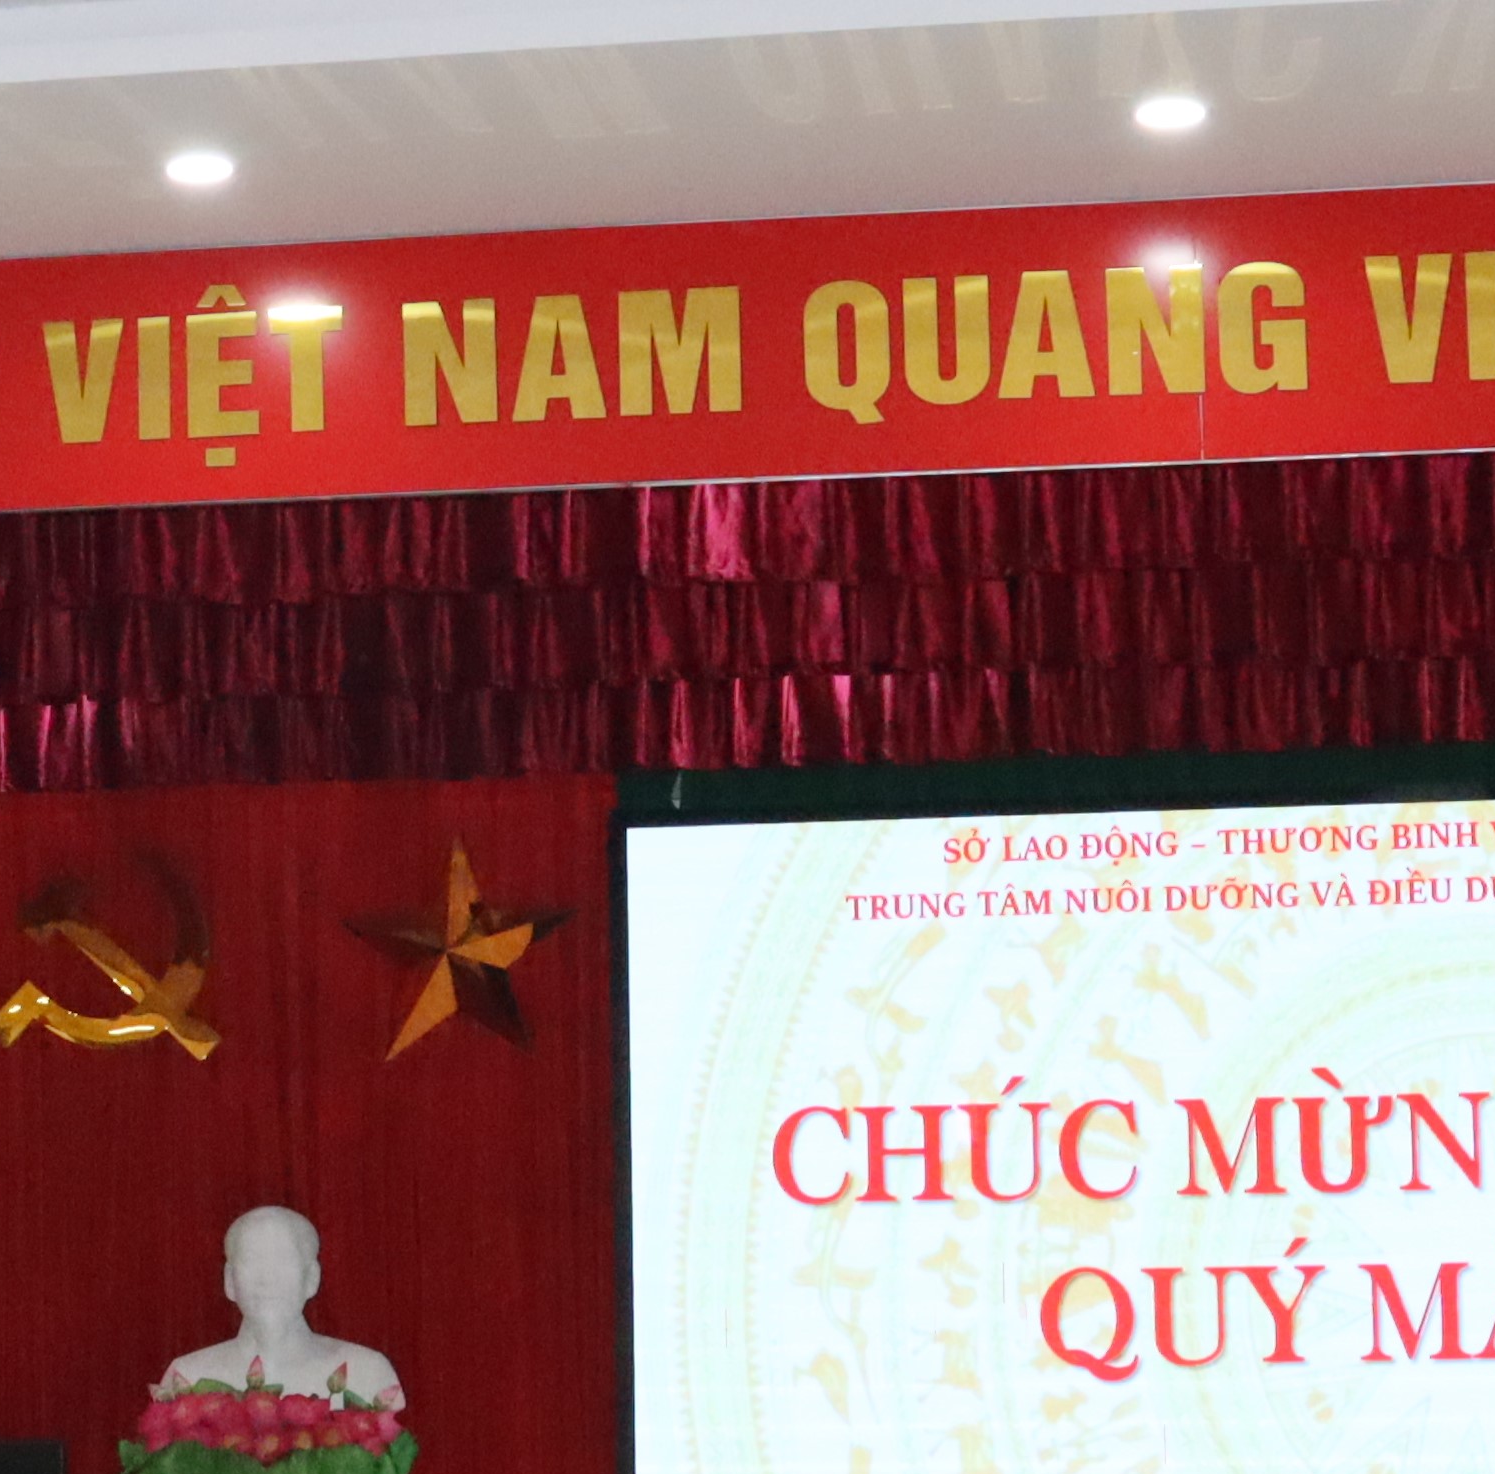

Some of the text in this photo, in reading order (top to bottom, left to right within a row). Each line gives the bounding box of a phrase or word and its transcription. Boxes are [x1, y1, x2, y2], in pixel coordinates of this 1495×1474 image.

[42, 282, 346, 467] VIỆT
[402, 287, 741, 426] NAM
[802, 258, 1309, 428] QUANG
[845, 892, 966, 921] TRUNG
[976, 883, 1053, 918] TÂM
[1065, 879, 1152, 915] NUÔI
[1164, 875, 1299, 913] DƯỠNG
[1308, 872, 1356, 909] VÀ
[1367, 866, 1453, 906] ĐIỀU
[943, 827, 991, 864] SỞ
[1002, 834, 1069, 862] LAO
[1079, 825, 1179, 867] ĐỘNG
[1217, 824, 1379, 855] THƯƠNG
[1390, 821, 1479, 850] BINH
[772, 1075, 1139, 1206] CHÚC
[1039, 1236, 1326, 1382] QUÝ
